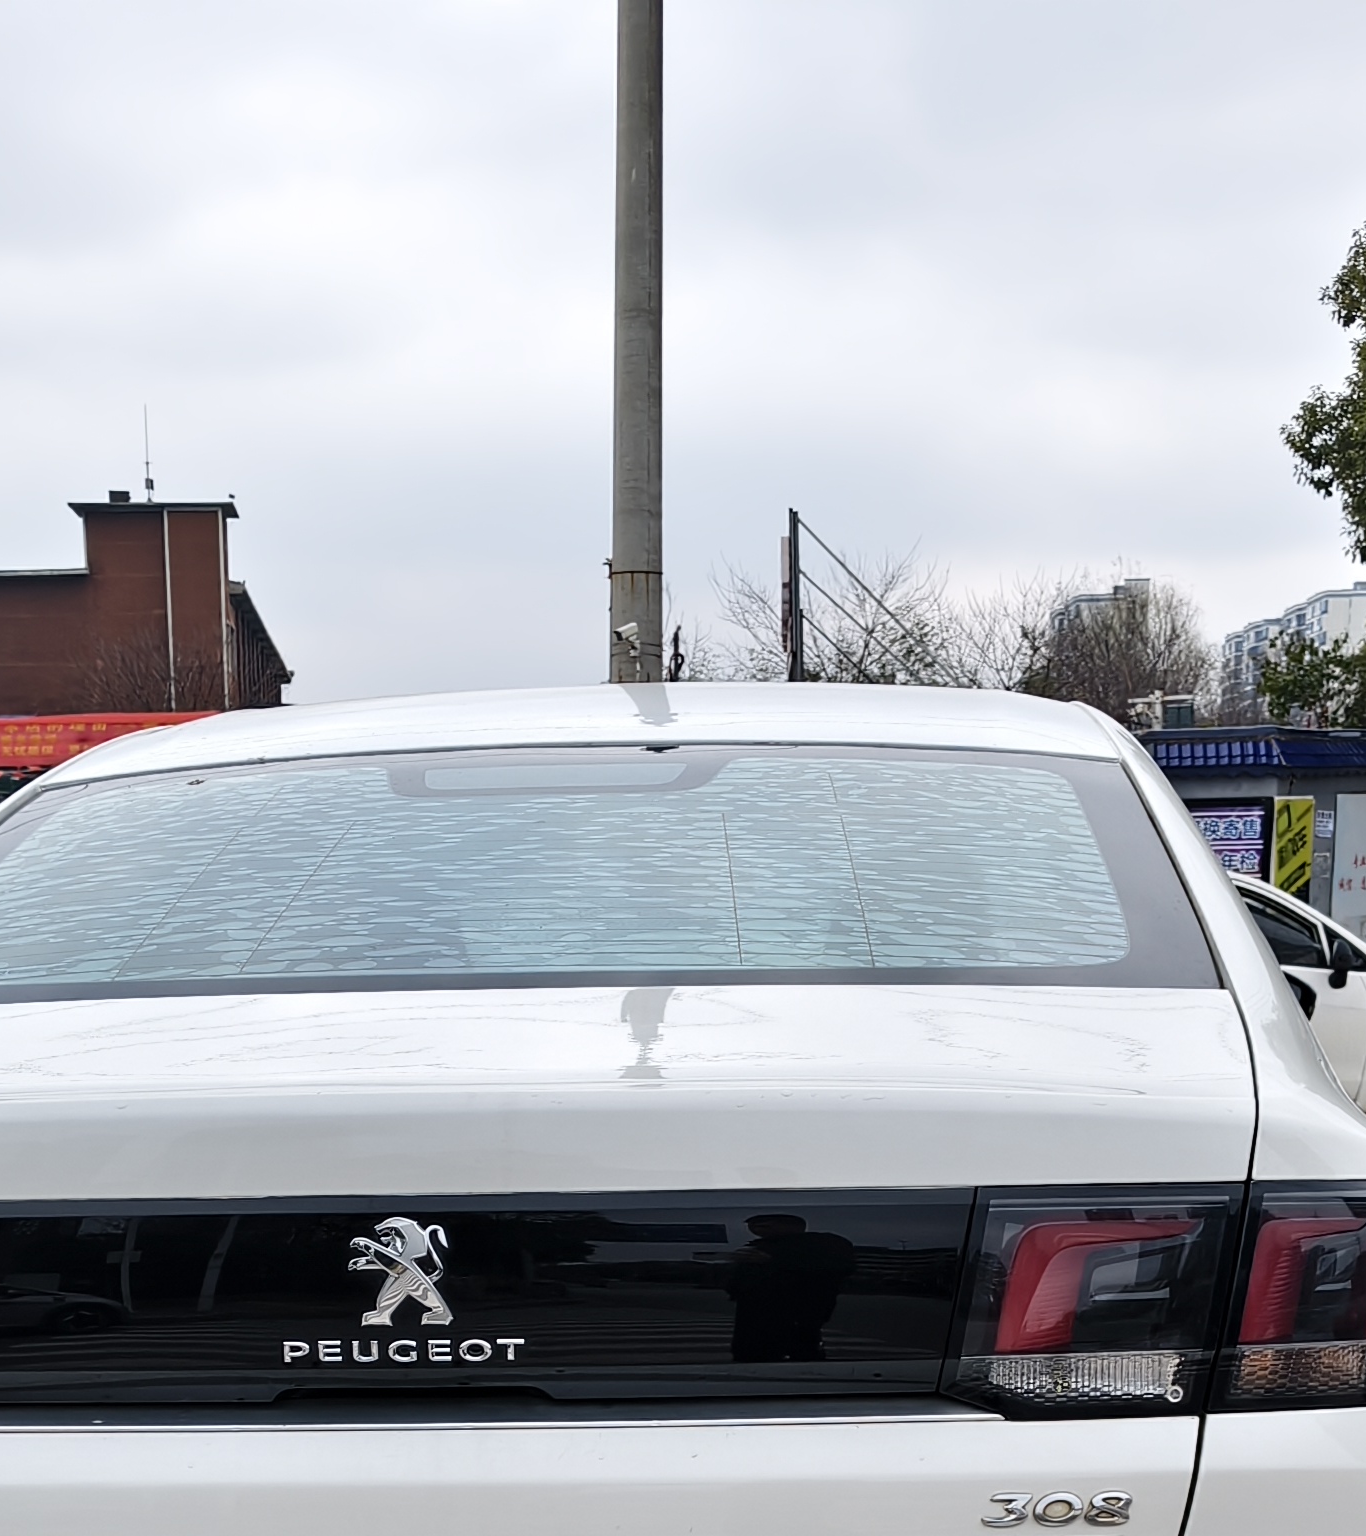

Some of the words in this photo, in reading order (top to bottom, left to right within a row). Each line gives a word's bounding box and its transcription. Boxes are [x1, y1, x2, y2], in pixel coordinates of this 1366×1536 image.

[1195, 816, 1262, 840] 换寄售
[282, 1338, 525, 1363] PEUGEOT
[981, 1490, 1133, 1528] 308
